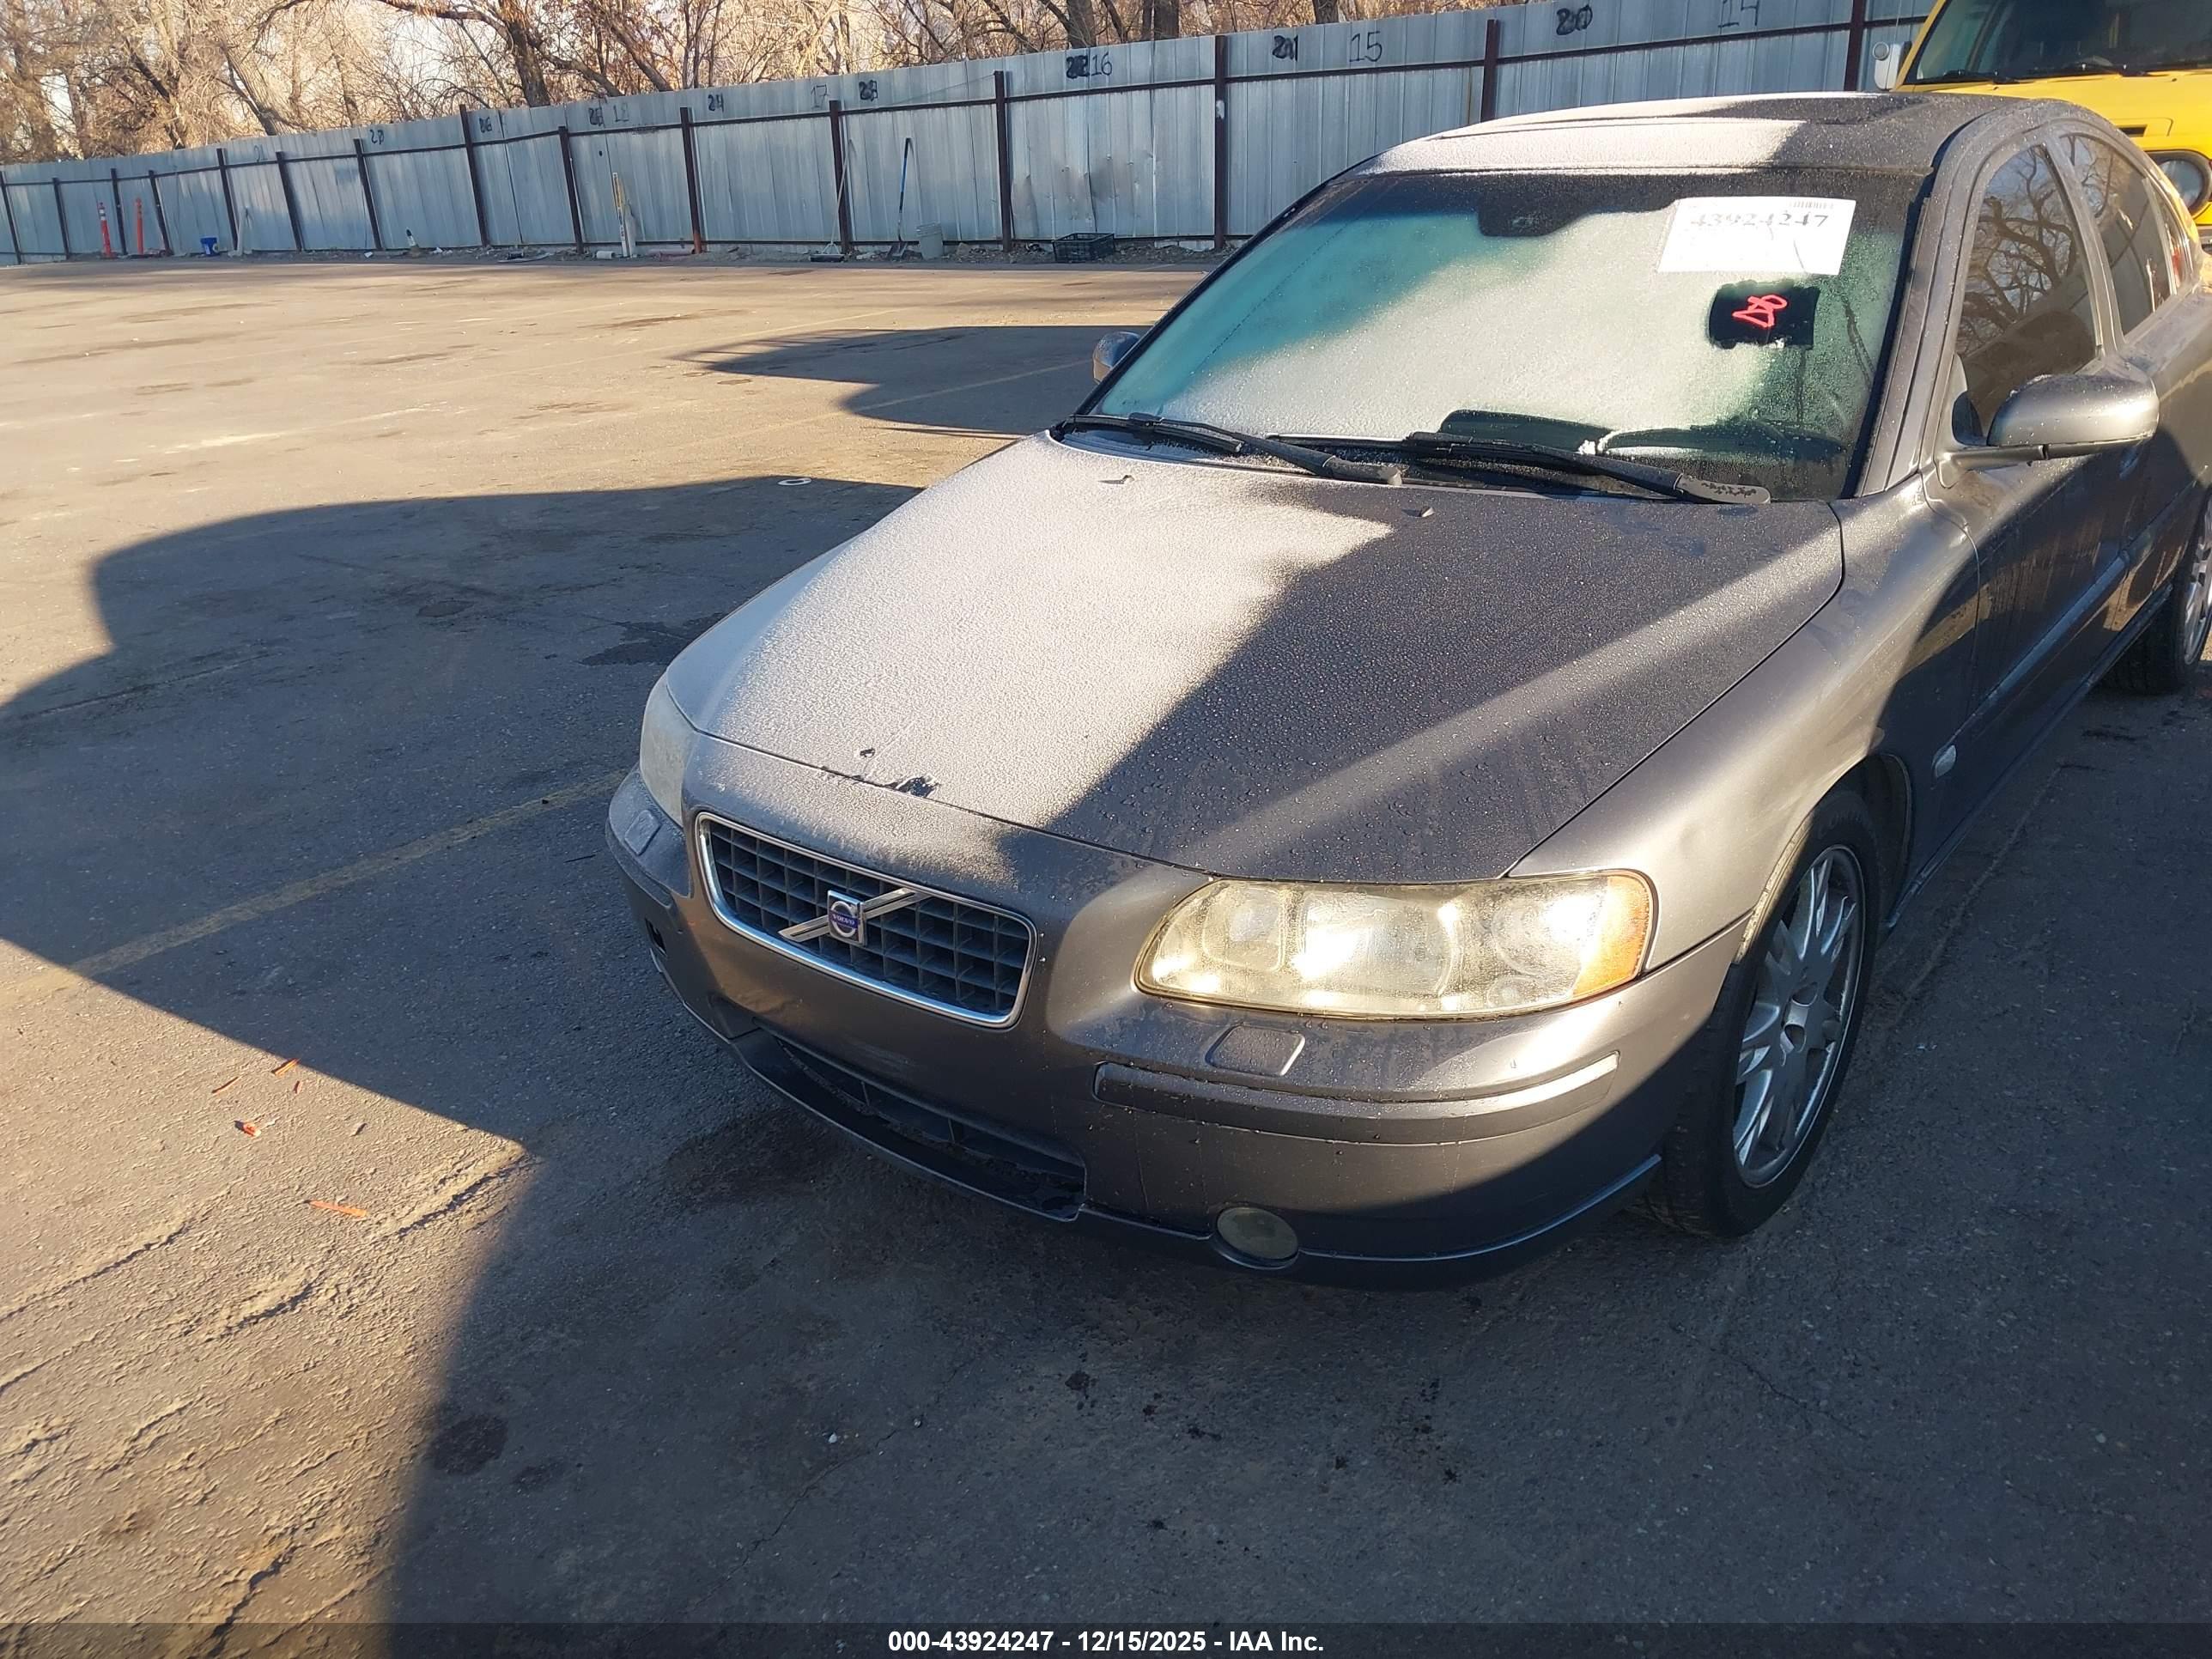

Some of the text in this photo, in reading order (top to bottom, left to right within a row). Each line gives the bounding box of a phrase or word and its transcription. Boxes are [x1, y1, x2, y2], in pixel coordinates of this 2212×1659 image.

[1349, 31, 1382, 63] 15
[1092, 54, 1113, 76] 16
[832, 912, 855, 926] VOLVO
